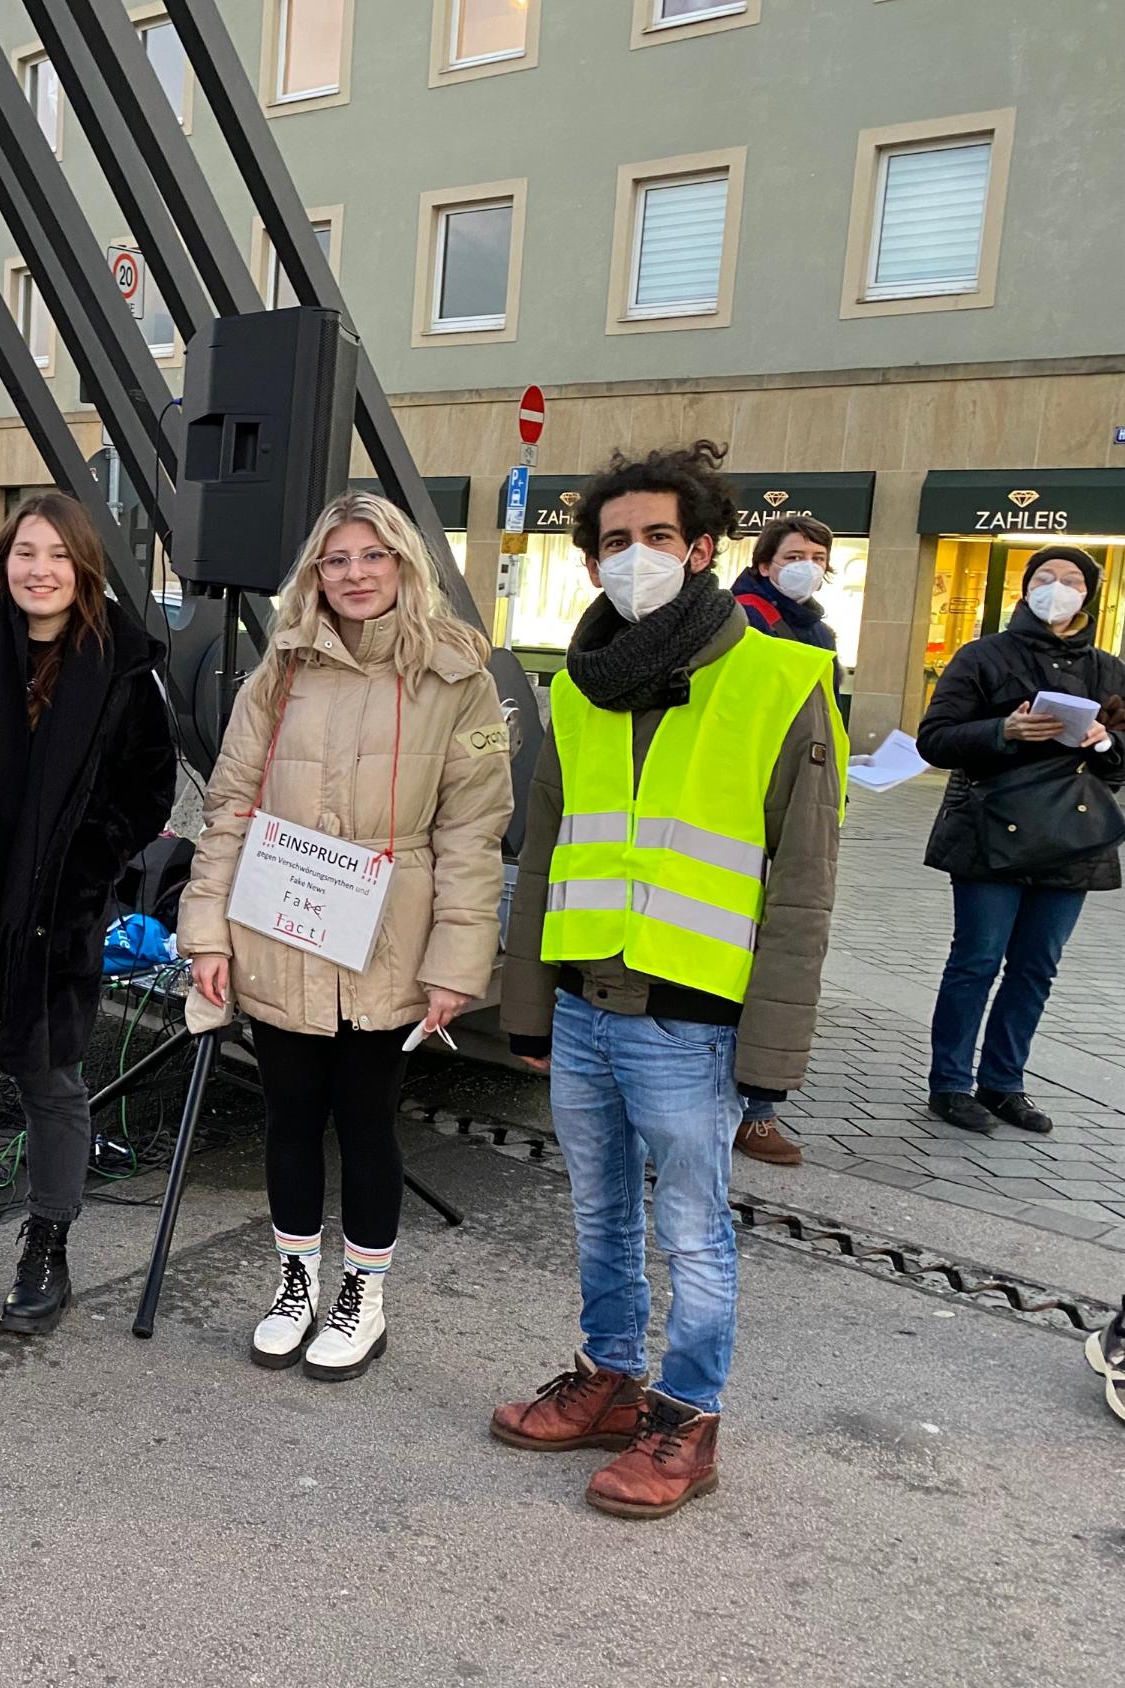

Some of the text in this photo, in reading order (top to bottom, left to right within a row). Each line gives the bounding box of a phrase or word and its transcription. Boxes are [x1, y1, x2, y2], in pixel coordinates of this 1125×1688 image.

[119, 265, 133, 287] 20
[975, 511, 1068, 530] ZAHLEIS
[256, 849, 277, 862] gegen
[278, 833, 359, 873] EINSPRUCH
[289, 875, 326, 895] Fake News
